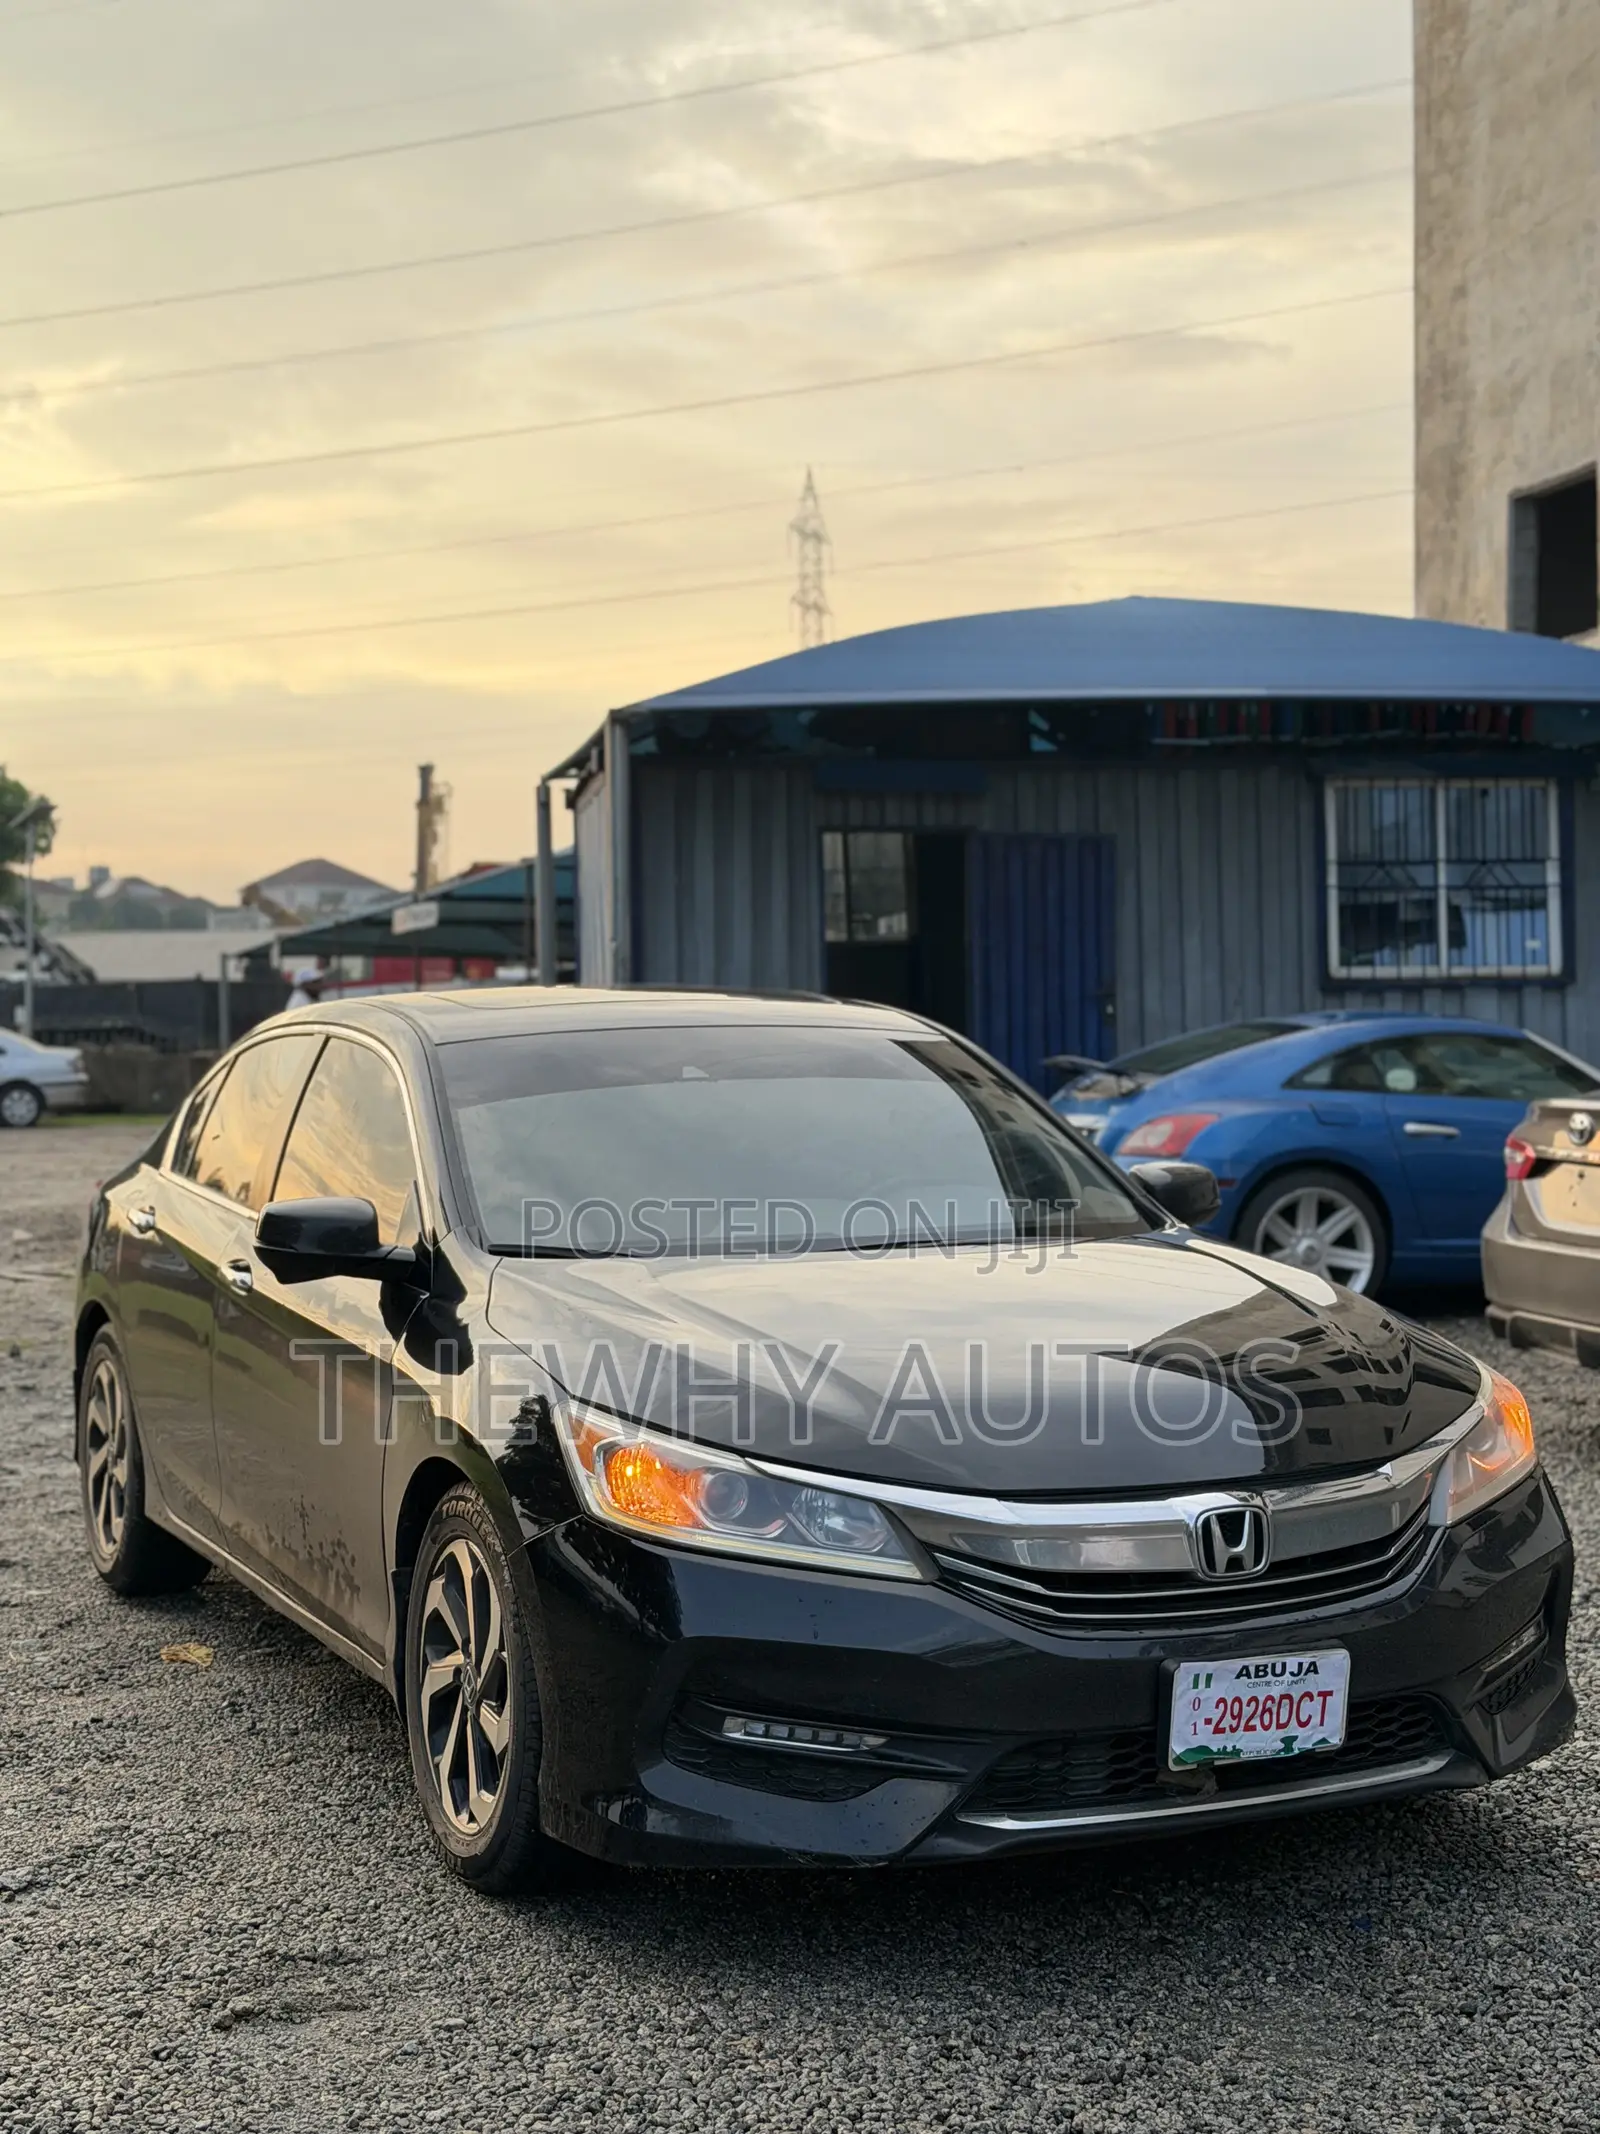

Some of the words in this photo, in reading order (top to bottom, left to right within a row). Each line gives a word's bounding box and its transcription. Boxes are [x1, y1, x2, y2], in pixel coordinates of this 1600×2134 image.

[1234, 1661, 1320, 1680] ABUJA
[1246, 1680, 1272, 1689] CENTRE
[1273, 1679, 1286, 1687] OF
[1286, 1678, 1307, 1687] UNITY
